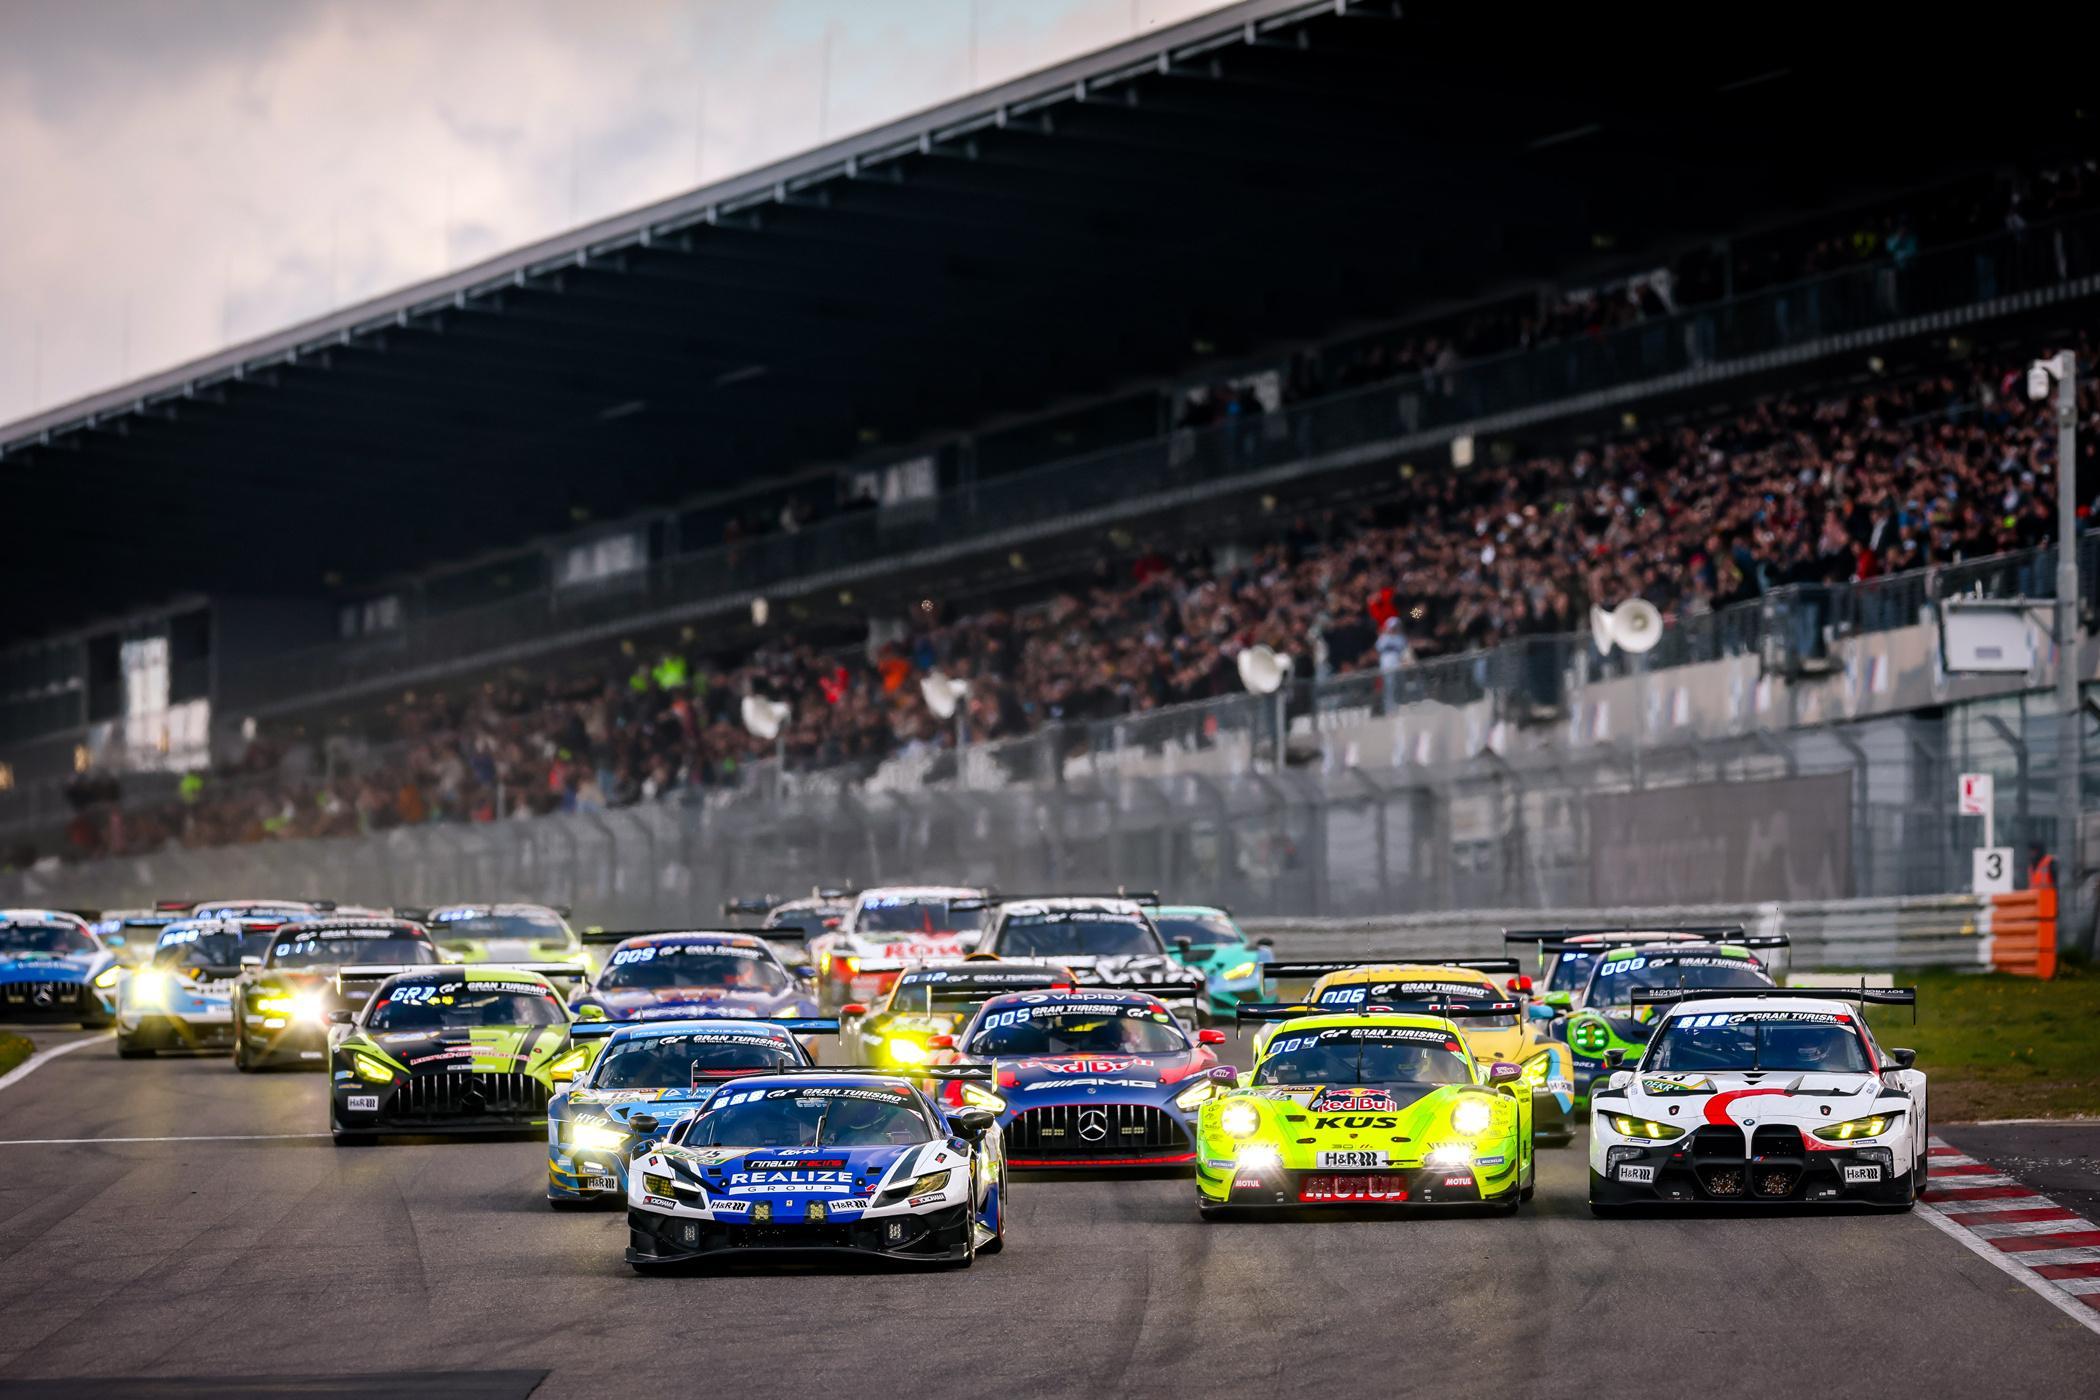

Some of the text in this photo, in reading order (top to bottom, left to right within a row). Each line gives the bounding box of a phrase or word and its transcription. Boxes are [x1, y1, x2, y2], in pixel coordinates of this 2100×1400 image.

[1986, 853, 2002, 880] 3
[467, 981, 498, 990] GRAN
[500, 982, 548, 994] TURISMO
[1401, 982, 1435, 992] GRAN
[1436, 983, 1485, 996] TURISMO
[1320, 988, 1367, 1004] 006
[1031, 1004, 1118, 1016] GRAN TURISMO
[984, 1008, 1030, 1030] 005
[1792, 1013, 1838, 1022] TURISM
[1350, 1028, 1448, 1040] GRAN TURISMO
[737, 1036, 788, 1049] TURISMO
[1071, 1078, 1157, 1089] AMG
[802, 1088, 841, 1096] GRAN
[842, 1089, 904, 1102] TURISMO
[1318, 1097, 1398, 1112] Red Bull
[574, 1112, 608, 1127] HYLO
[1314, 1116, 1399, 1130] KÜS
[730, 1171, 853, 1184] REALIZE
[1620, 1167, 1639, 1178] H&R
[1846, 1169, 1866, 1179] H&R
[1445, 1178, 1472, 1186] MOTUL
[710, 1200, 733, 1210] H&R
[830, 1200, 855, 1210] H&R
